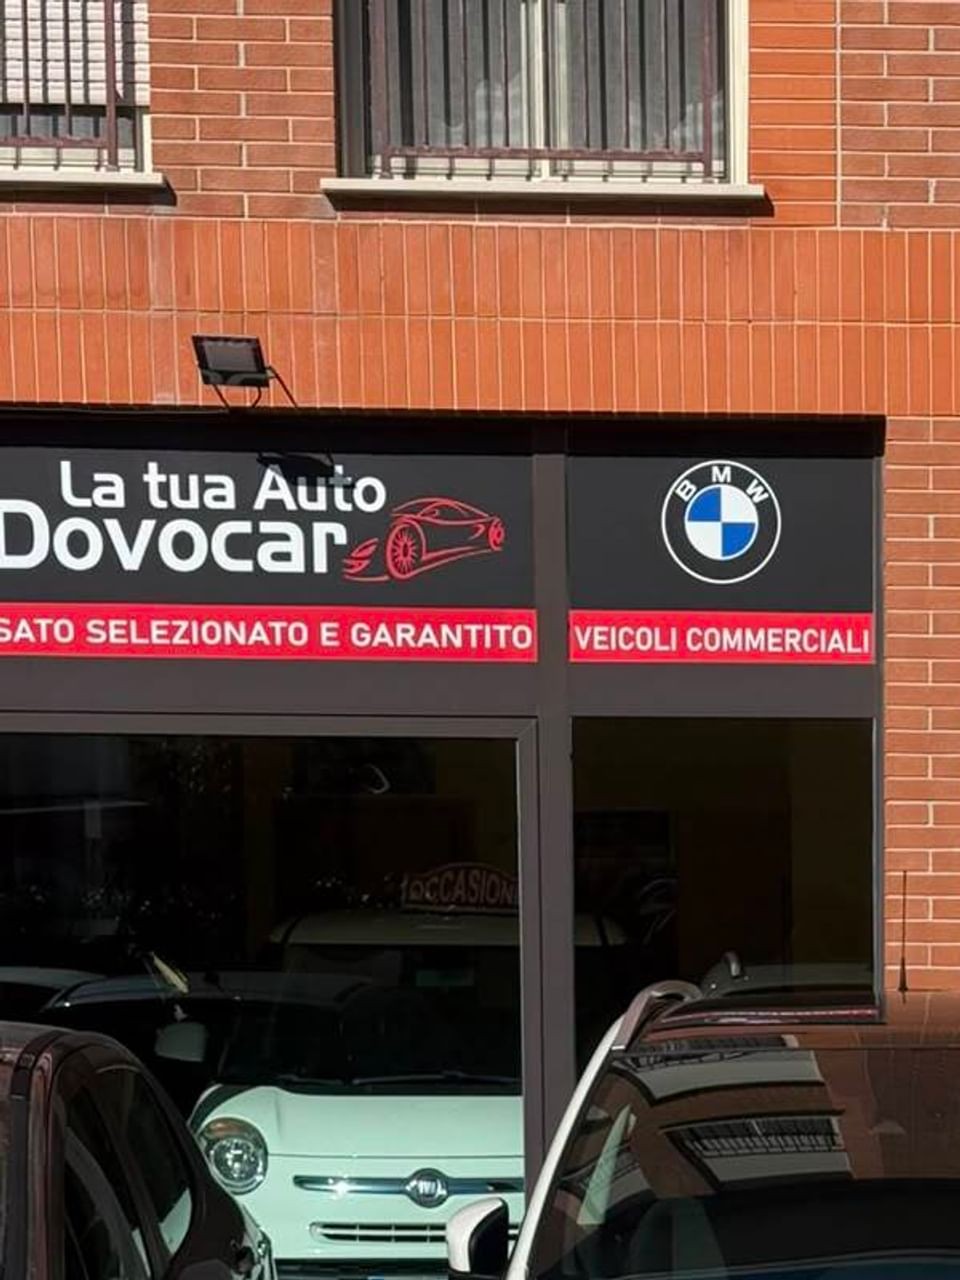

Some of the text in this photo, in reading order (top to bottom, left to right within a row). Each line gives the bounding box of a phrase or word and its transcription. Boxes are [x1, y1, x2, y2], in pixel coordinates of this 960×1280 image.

[60, 460, 386, 512] La tua Auto
[675, 466, 768, 503] BMW
[0, 499, 347, 573] Dovocar
[86, 619, 309, 646] SELEZIONATO
[320, 622, 340, 646] E
[351, 623, 533, 650] GARANTITO
[575, 626, 869, 654] VEICOLI COMMERCIALI
